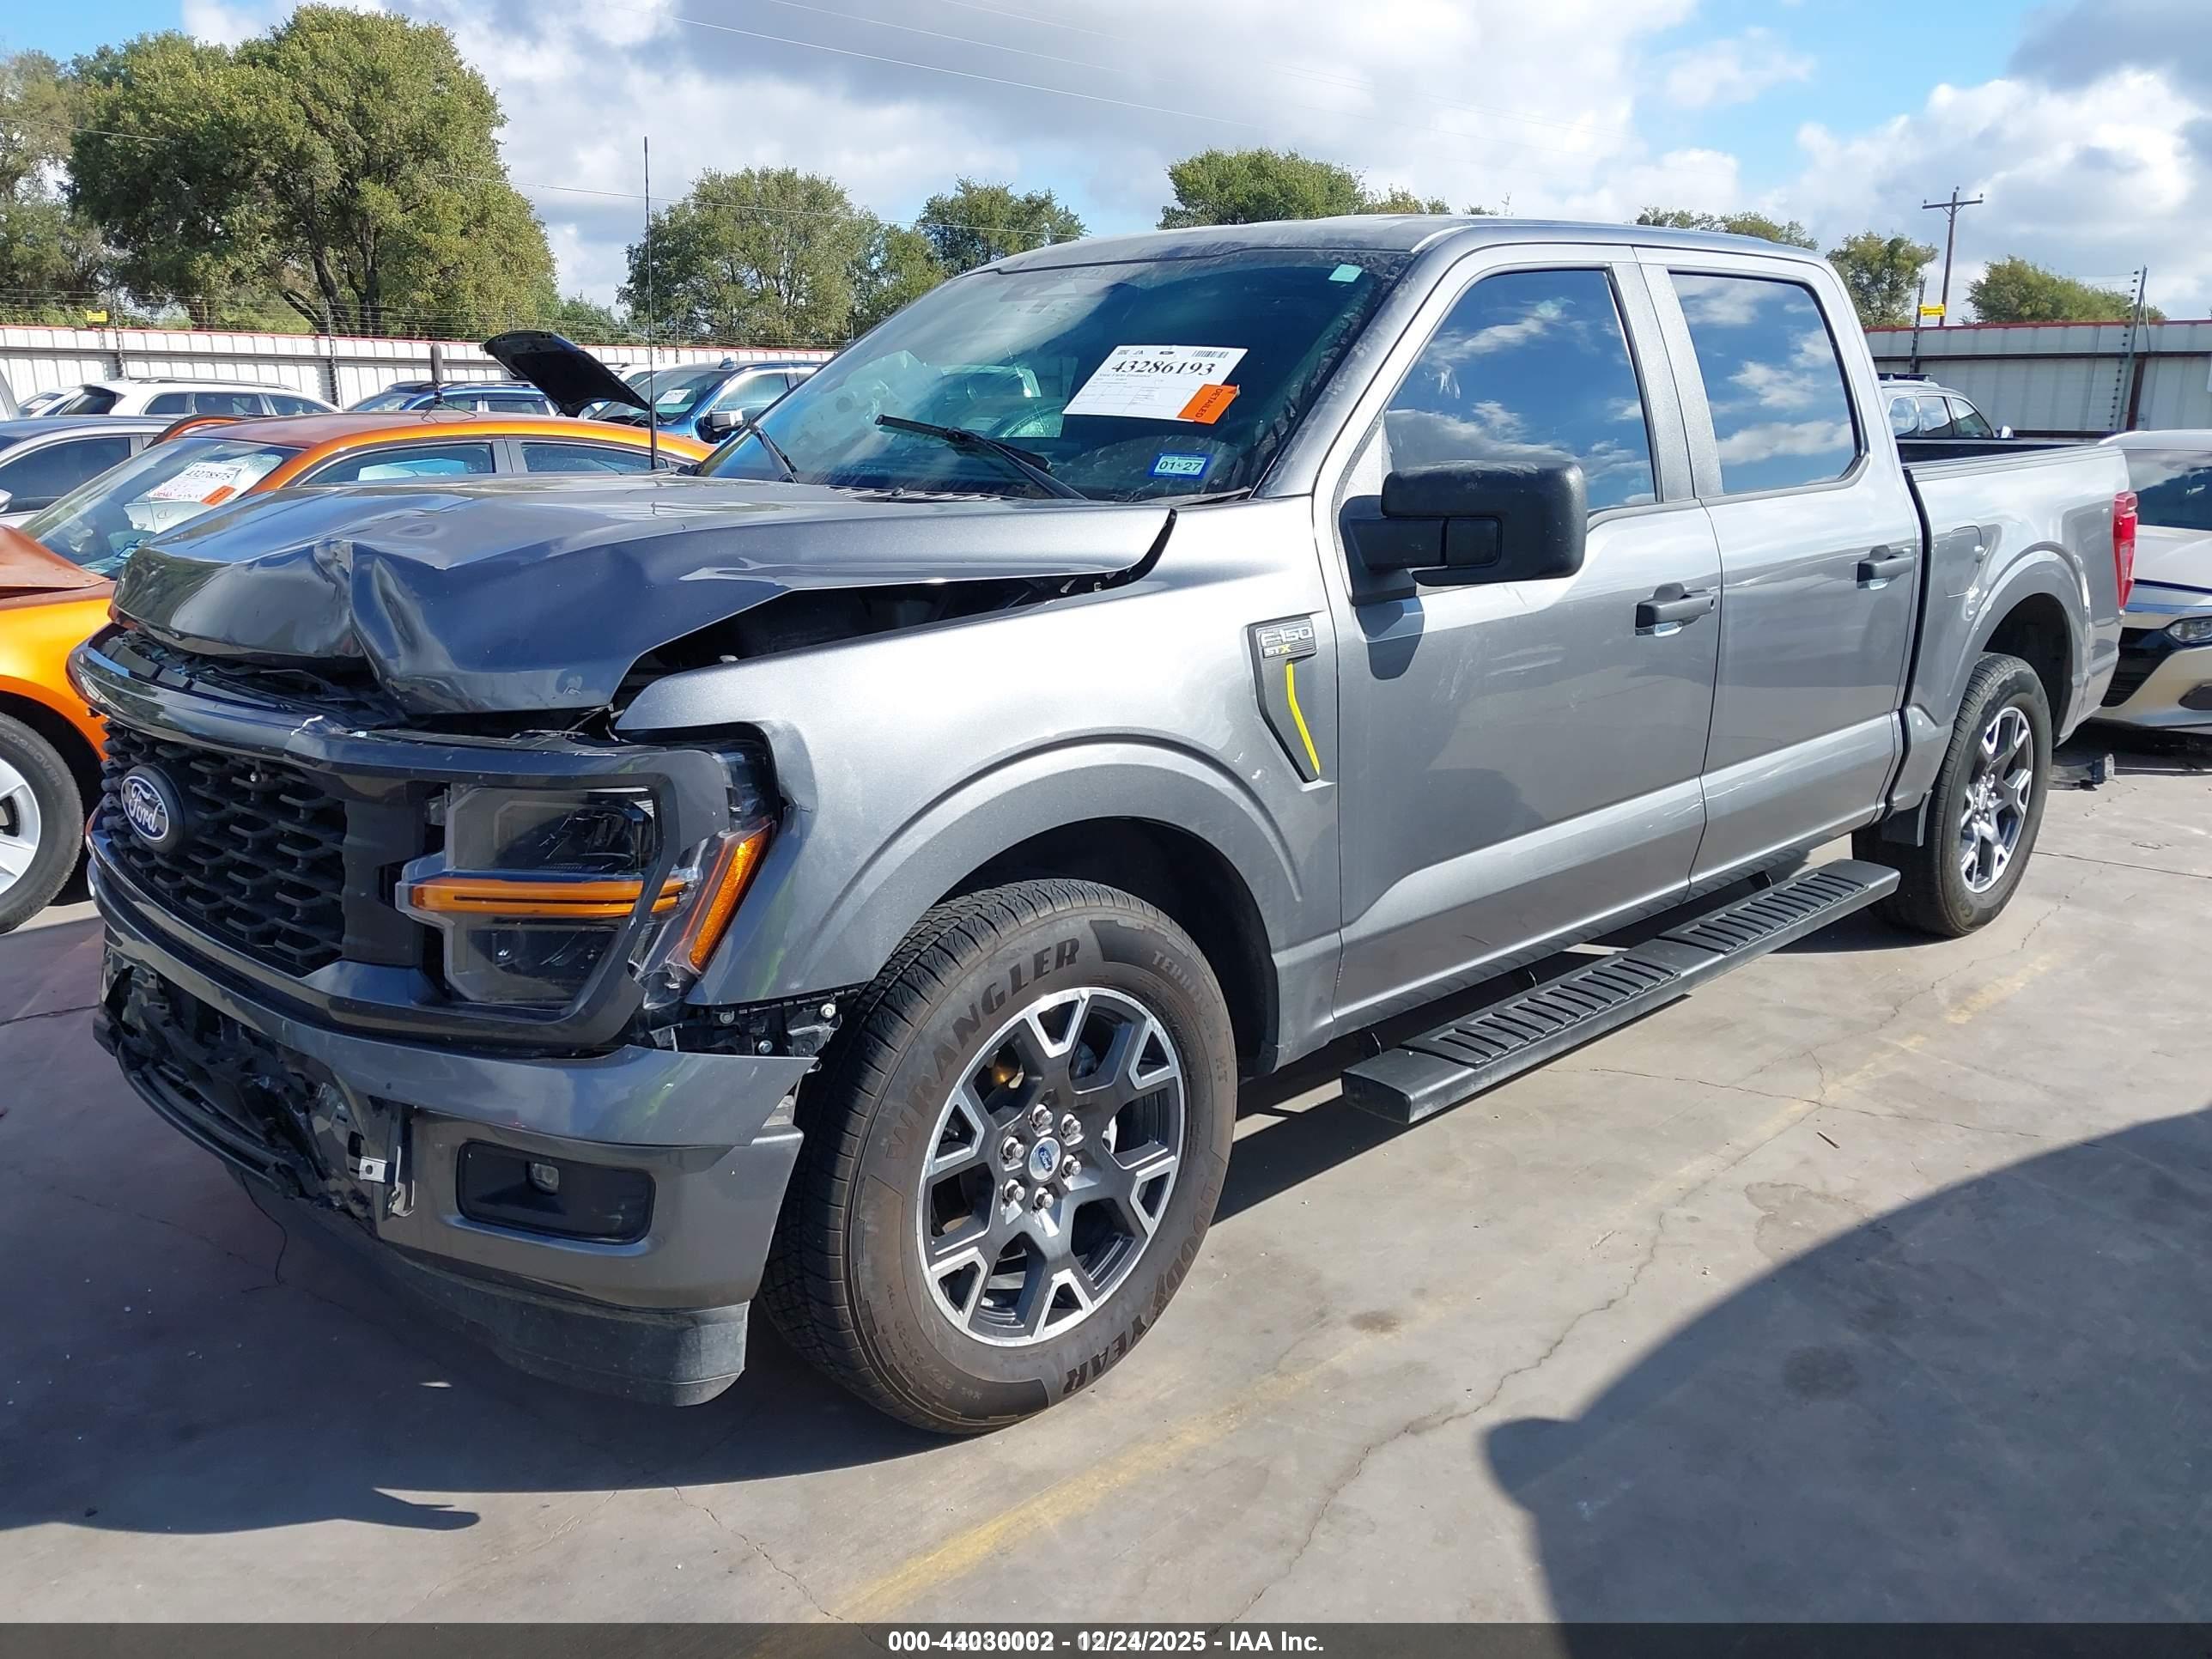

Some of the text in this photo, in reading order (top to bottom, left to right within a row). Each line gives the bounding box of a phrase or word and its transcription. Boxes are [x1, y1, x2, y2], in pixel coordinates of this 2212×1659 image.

[1111, 360, 1216, 376] 43286193
[1195, 388, 1223, 417] DETAILED
[1159, 460, 1203, 471] 01 27
[1261, 627, 1313, 647] F-150
[1265, 644, 1292, 655] STX
[128, 782, 162, 833] Ford
[885, 938, 1080, 1161] WRANGLER
[1039, 1150, 1052, 1170] Ford
[1062, 1187, 1218, 1395] GOODYEAR
